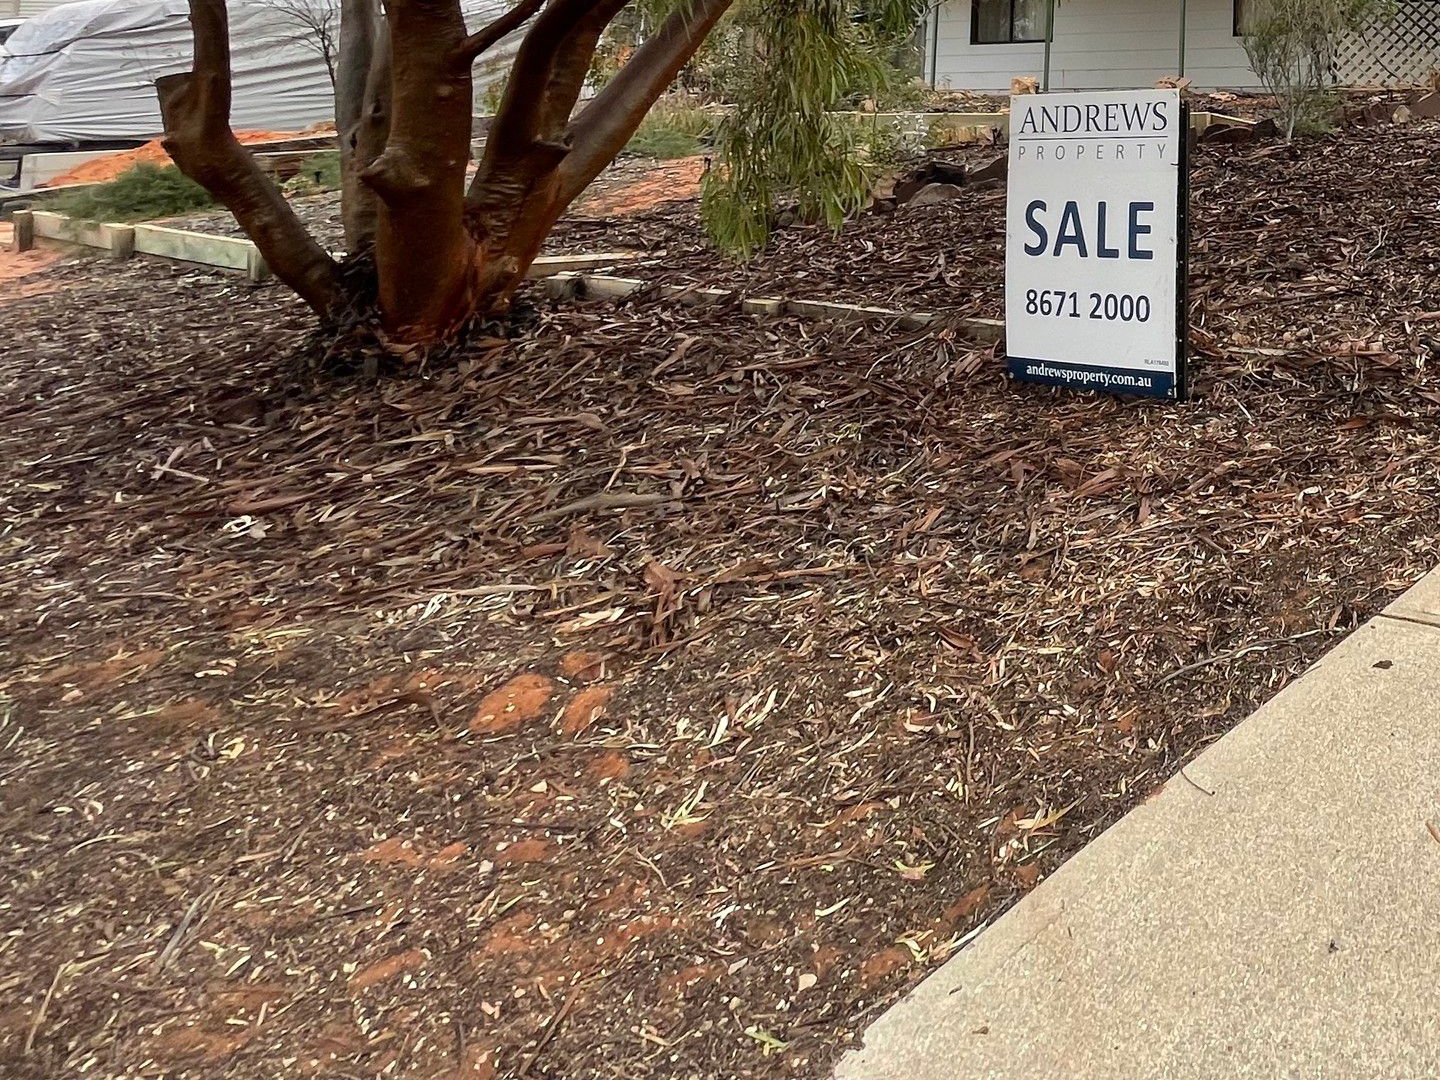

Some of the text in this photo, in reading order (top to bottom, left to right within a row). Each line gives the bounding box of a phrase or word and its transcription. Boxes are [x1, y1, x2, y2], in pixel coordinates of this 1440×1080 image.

[1019, 101, 1168, 134] ANDREWS
[1018, 143, 1167, 160] PROPERTY
[1023, 199, 1154, 260] SALE
[1026, 289, 1150, 323] 8671 2000
[1026, 364, 1152, 388] andrewsproperty.com.au
